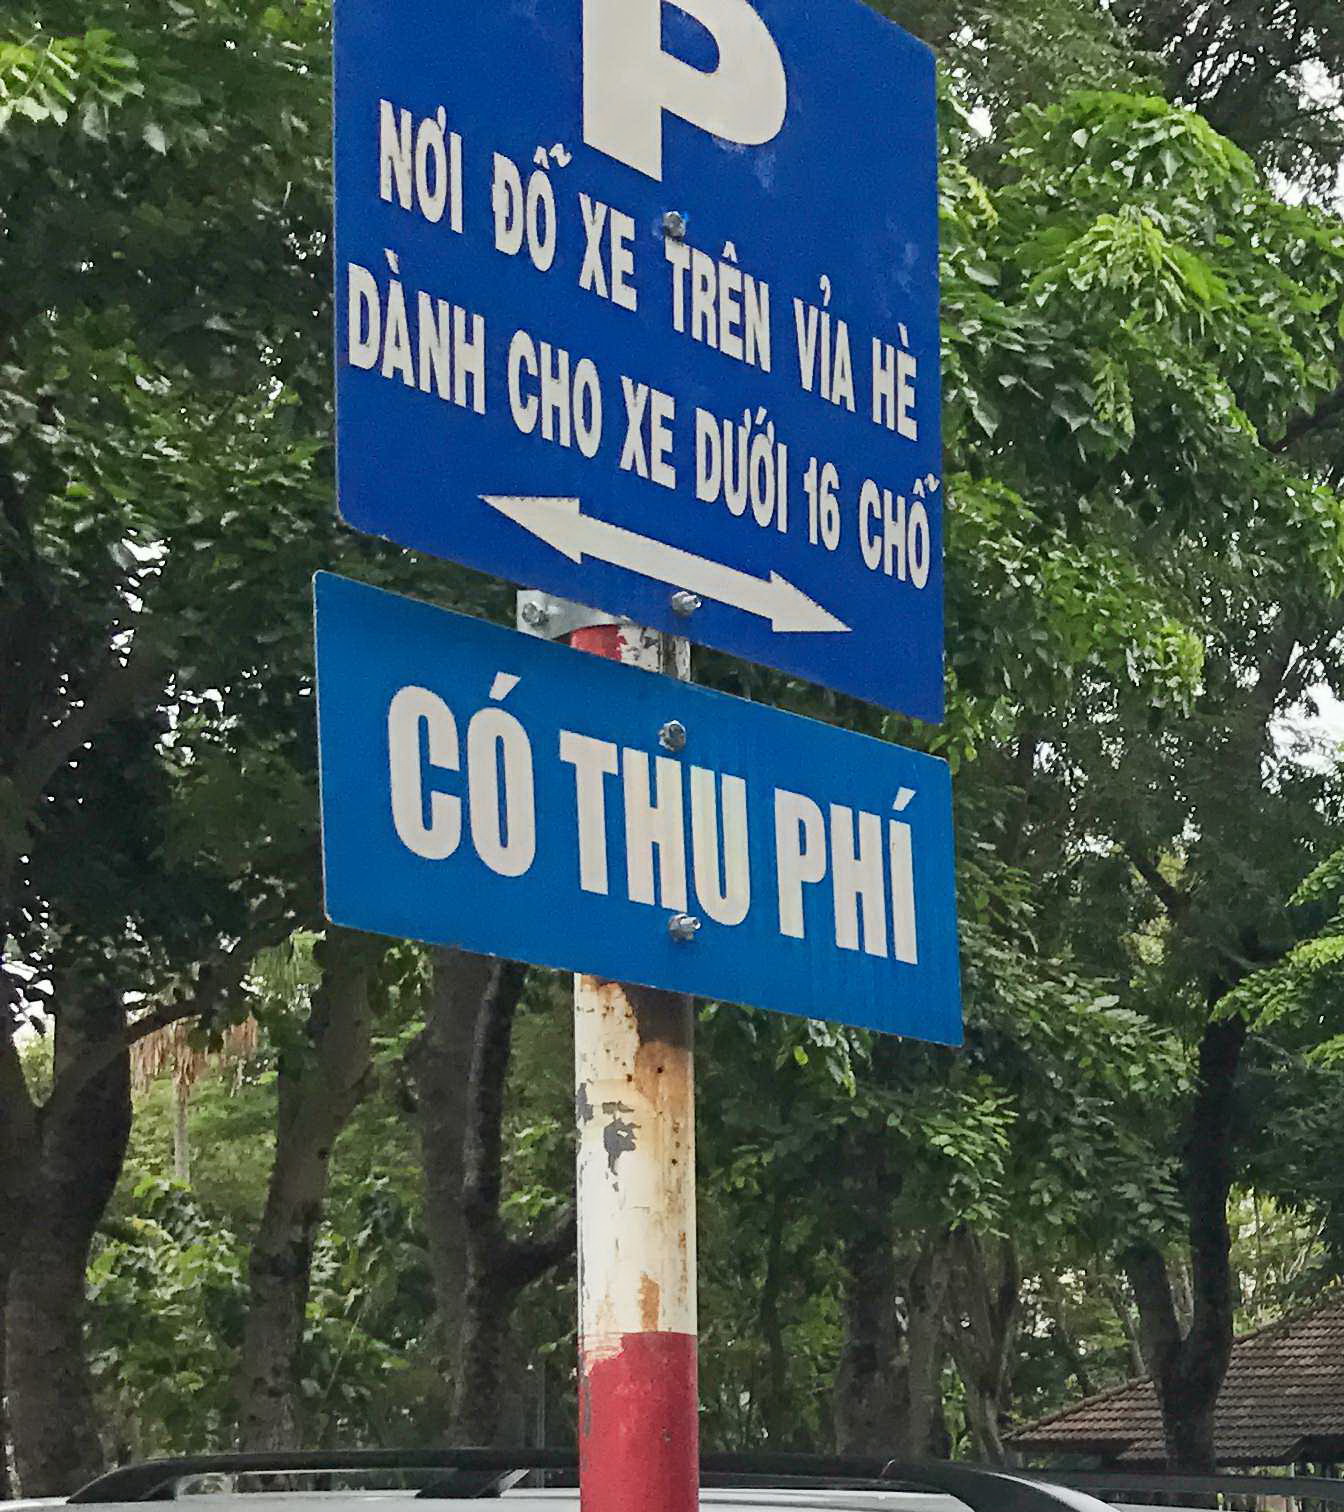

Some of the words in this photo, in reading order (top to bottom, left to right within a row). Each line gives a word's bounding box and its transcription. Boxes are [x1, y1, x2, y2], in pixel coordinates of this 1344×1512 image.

[582, 0, 787, 182] P
[347, 248, 487, 416] DÀNH
[507, 329, 602, 459] CHO
[620, 375, 677, 490] XE
[696, 406, 788, 534] DƯỚI
[803, 456, 842, 551] 16
[859, 473, 941, 591] CHỖ
[379, 98, 463, 233] NƠI
[491, 142, 573, 272] ĐỖ
[579, 192, 638, 311] XE
[664, 238, 772, 372] TRÊN
[794, 275, 856, 413] VỈA
[872, 322, 919, 442] HÈ
[387, 671, 537, 878] CÓ
[558, 729, 752, 927] THU
[773, 787, 919, 966] PHÍ
